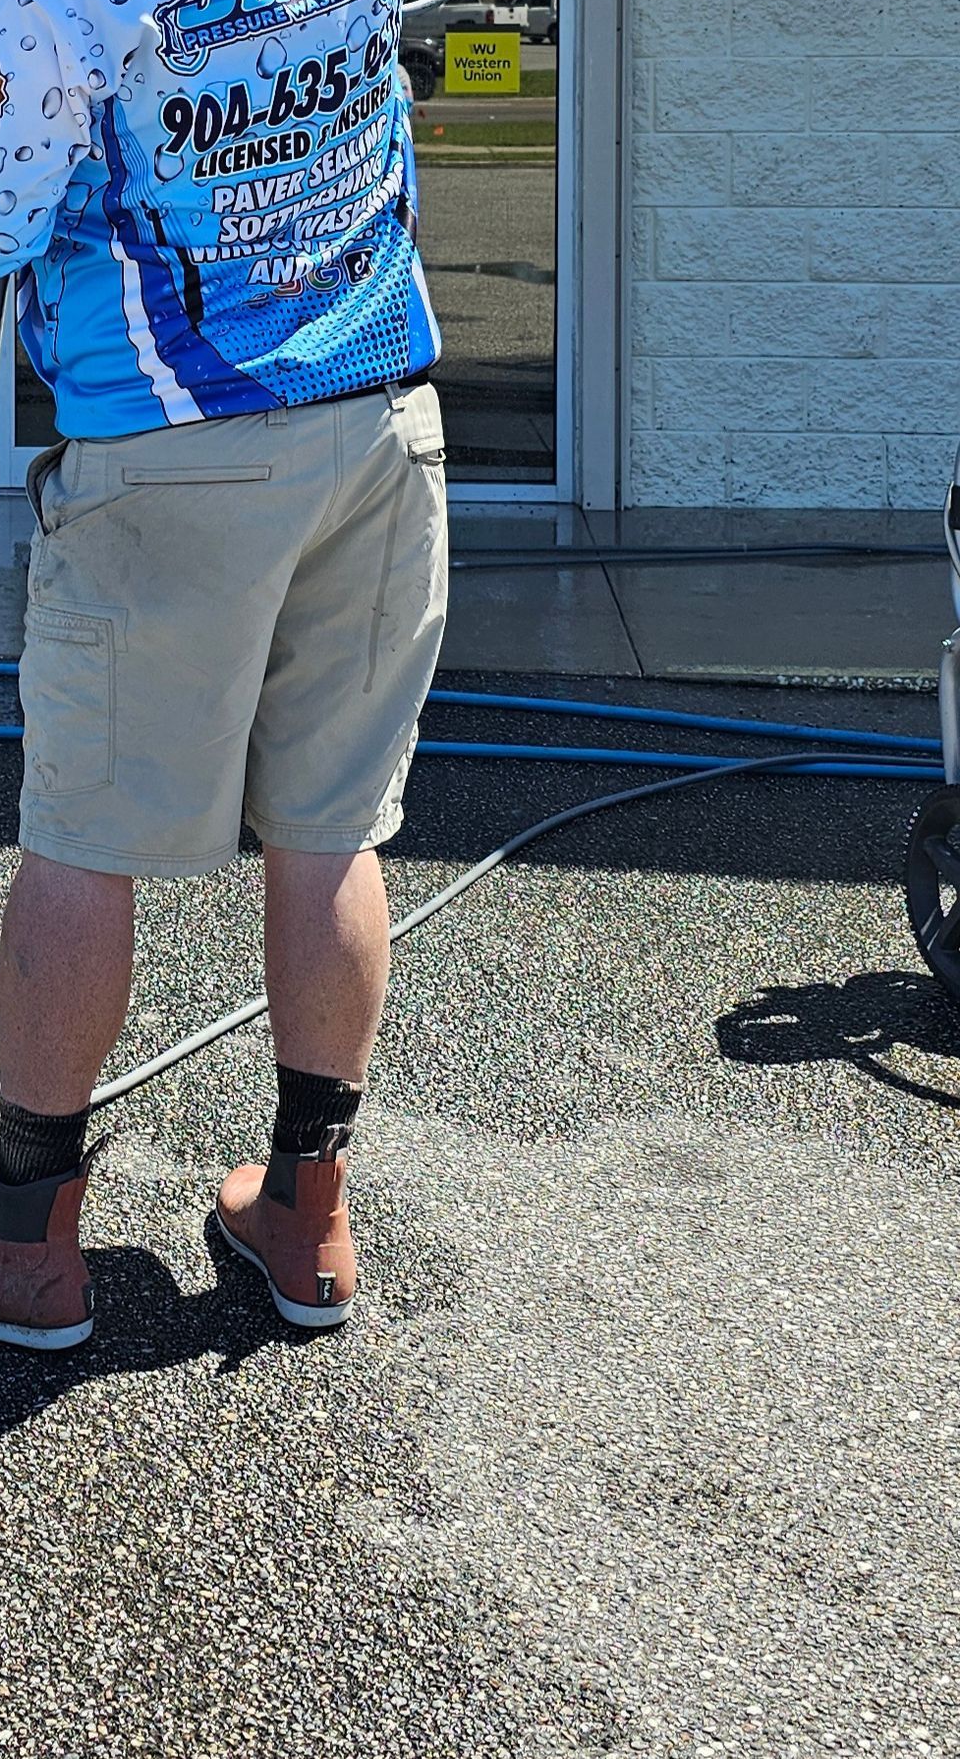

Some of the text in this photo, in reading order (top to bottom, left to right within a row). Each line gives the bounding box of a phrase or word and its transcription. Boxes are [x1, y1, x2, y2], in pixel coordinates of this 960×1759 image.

[185, 5, 287, 50] PRESSURE
[454, 58, 511, 69] Western
[471, 43, 496, 55] WU
[464, 69, 502, 81] Union
[194, 130, 311, 178] LICENSED
[214, 170, 306, 213] PAVER
[248, 256, 315, 285] AND
